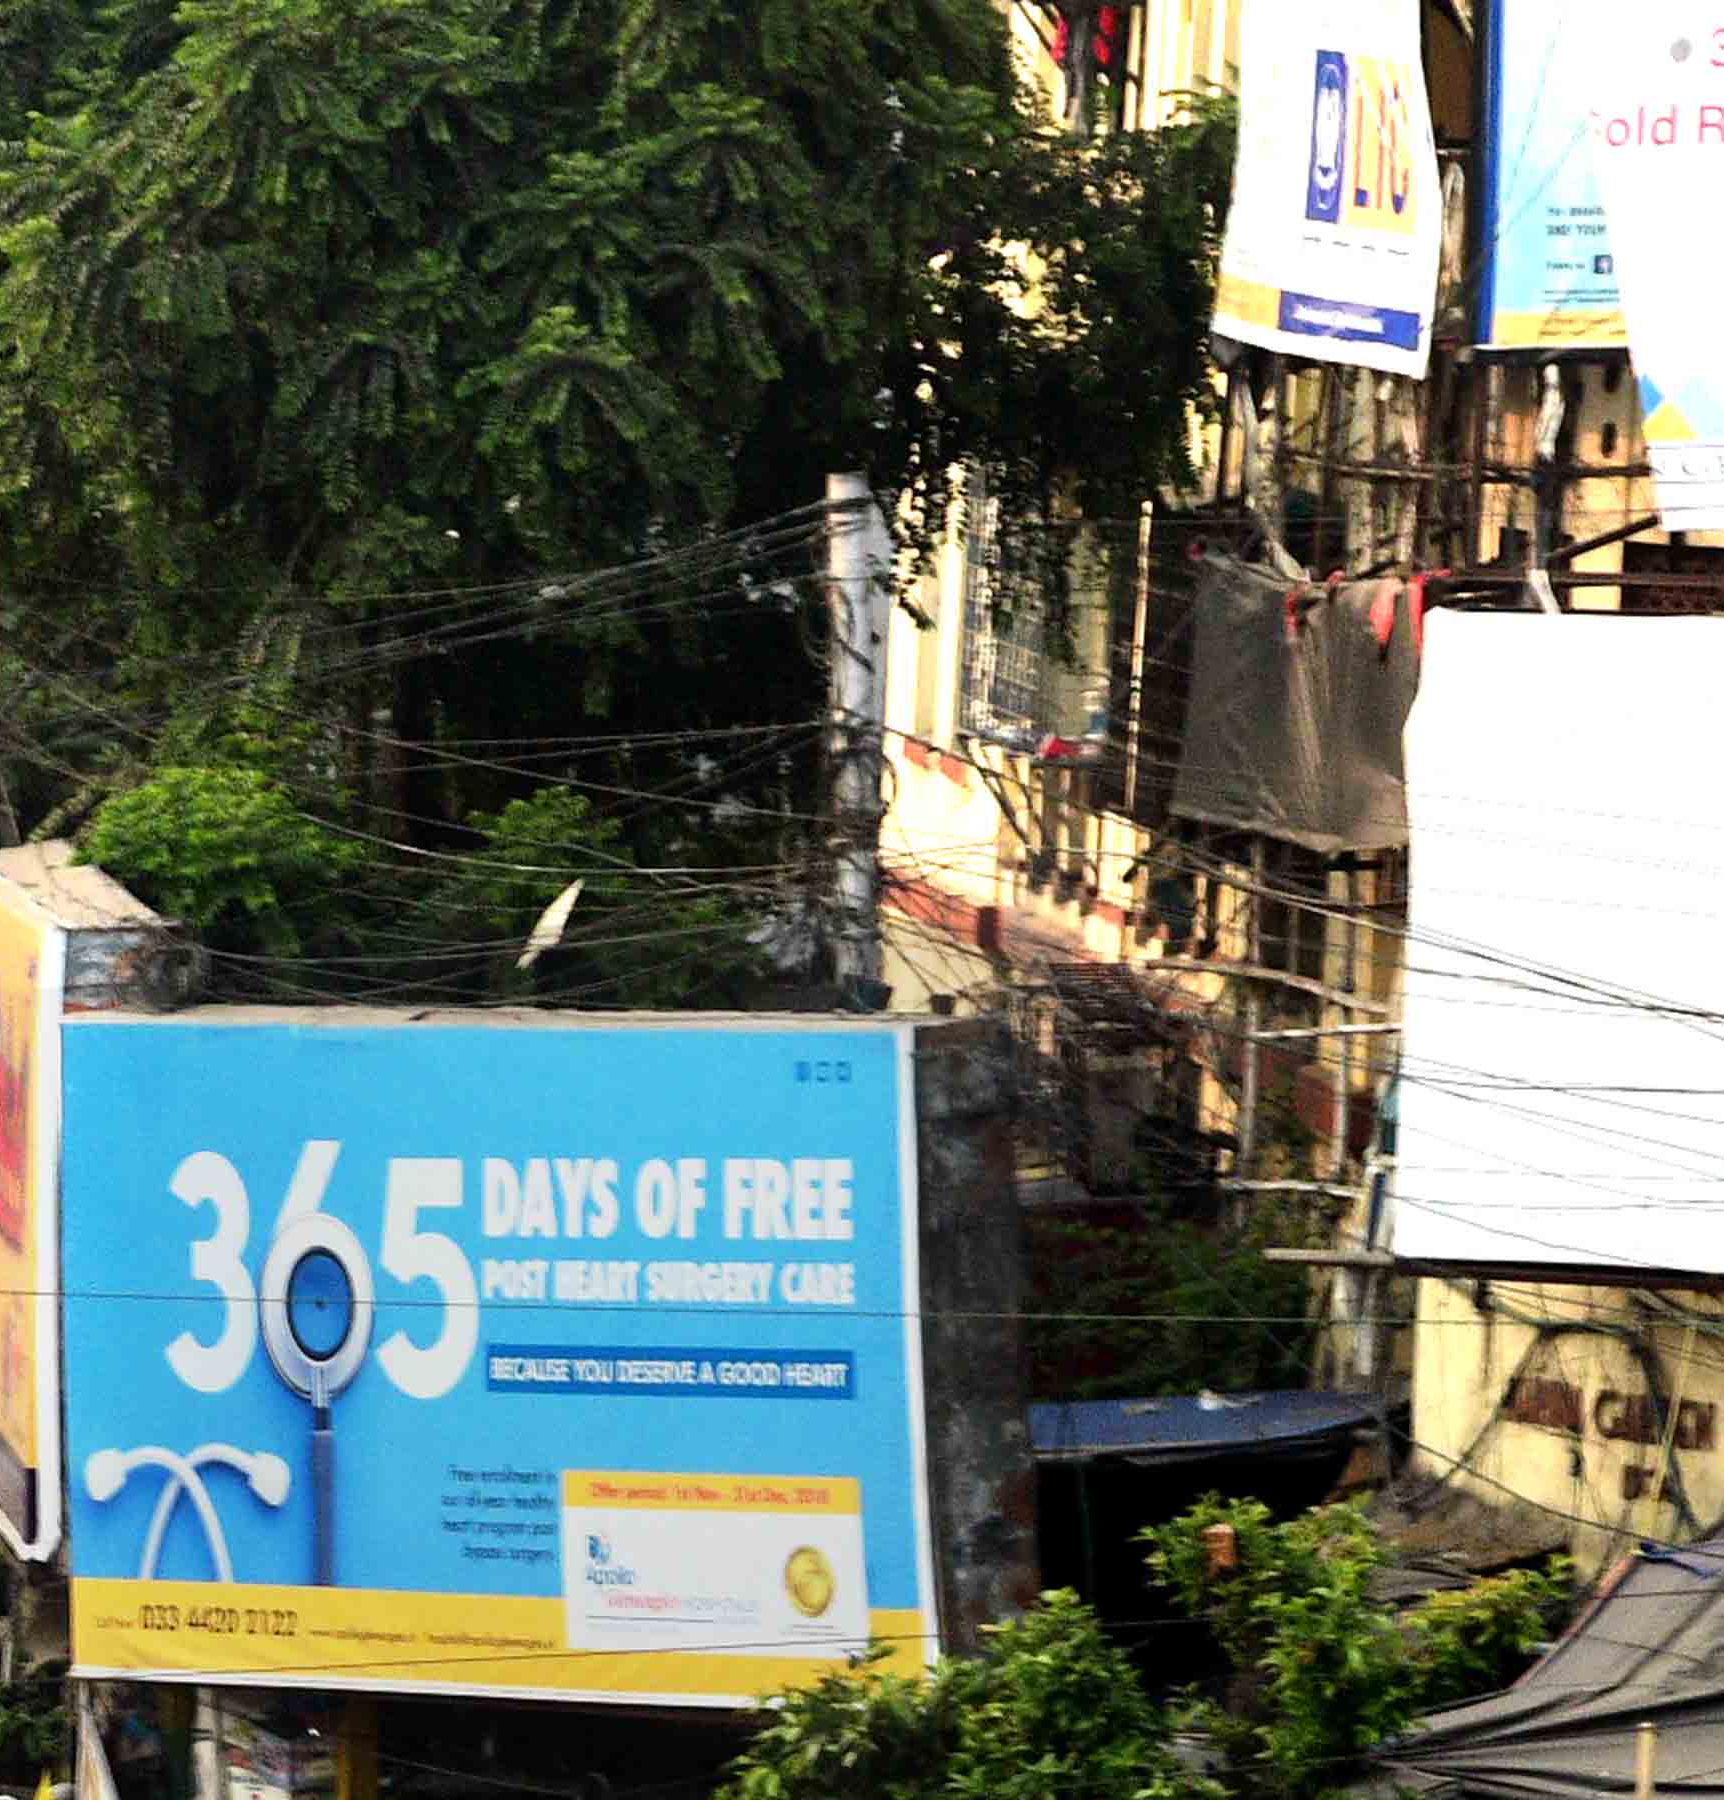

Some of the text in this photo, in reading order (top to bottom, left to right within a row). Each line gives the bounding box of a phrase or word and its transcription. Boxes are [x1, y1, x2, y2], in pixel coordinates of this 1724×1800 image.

[1589, 104, 1676, 147] old
[483, 1156, 854, 1241] DAYS OF FREE
[165, 1139, 479, 1399] 365
[483, 1259, 855, 1305] POST HEART SURGERY CARE
[489, 1356, 848, 1388] BECAUSE YOU DESERVE A GOOD HEART
